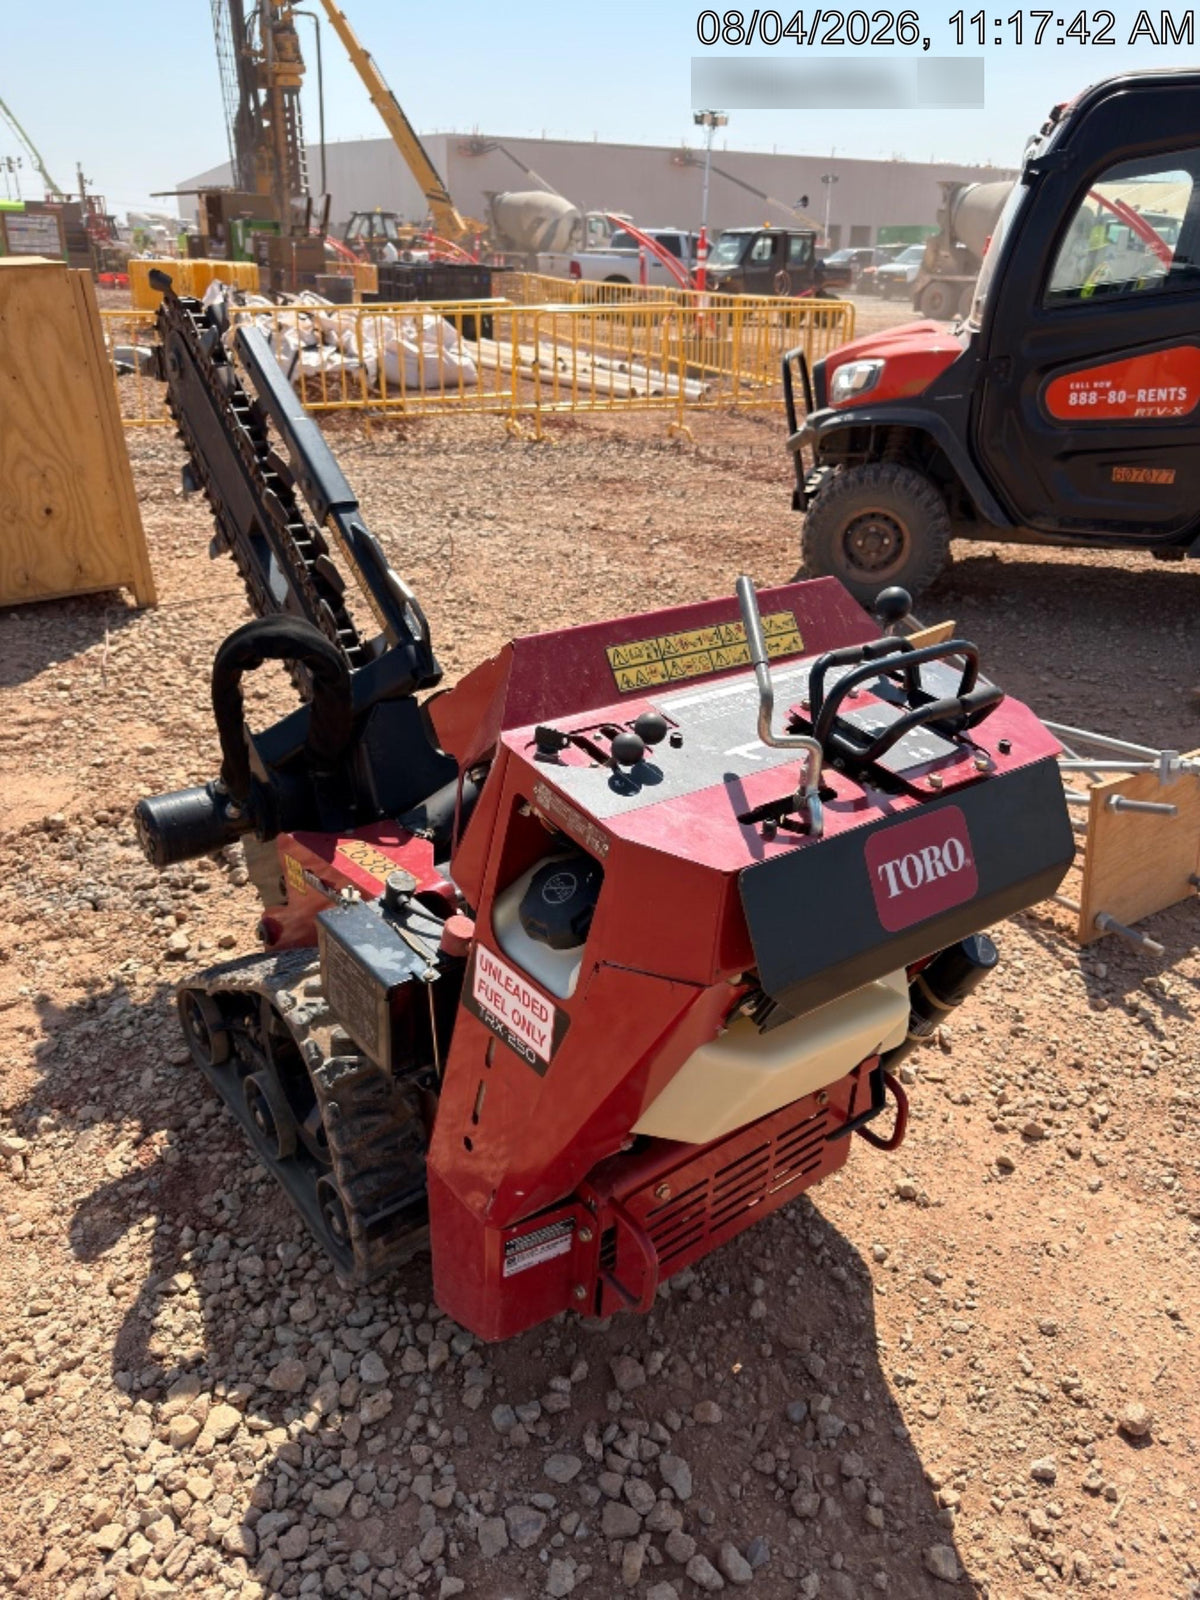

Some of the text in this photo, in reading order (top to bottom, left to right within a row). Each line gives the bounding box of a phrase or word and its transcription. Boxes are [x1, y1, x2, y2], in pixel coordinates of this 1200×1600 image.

[1068, 387, 1188, 406] 888-80-RENTS
[1069, 382, 1090, 390] CALL
[1134, 406, 1185, 417] RTV-X
[877, 837, 965, 899] TORO
[479, 954, 549, 1023] UNLEADED
[477, 978, 547, 1048] FUEL ONLY
